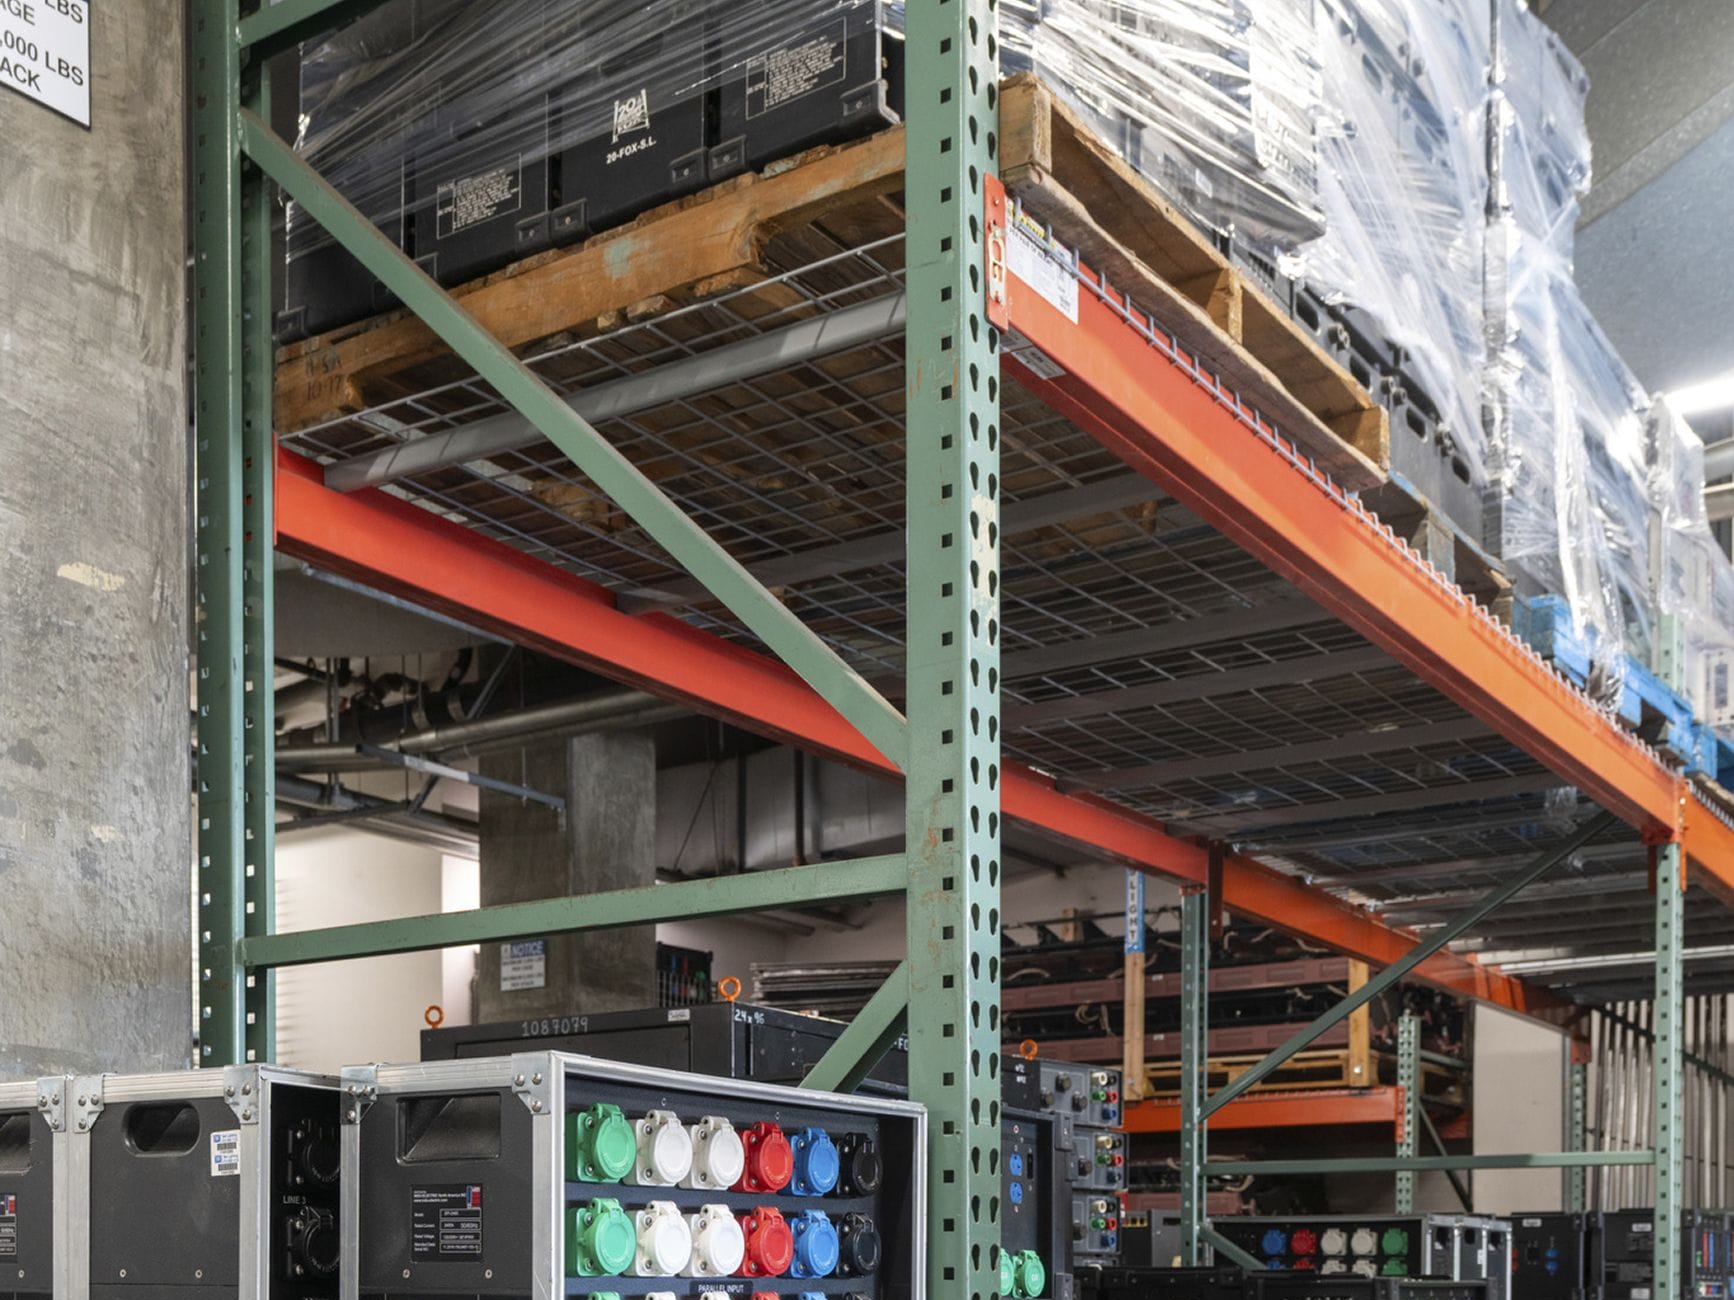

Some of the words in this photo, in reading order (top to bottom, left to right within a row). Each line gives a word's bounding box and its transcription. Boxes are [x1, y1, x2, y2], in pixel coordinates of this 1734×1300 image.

[0, 0, 35, 26] GE
[45, 51, 84, 86] LBS
[521, 1017, 589, 1037] 1087079
[283, 1195, 300, 1205] LINE
[727, 1285, 744, 1293] INPUT
